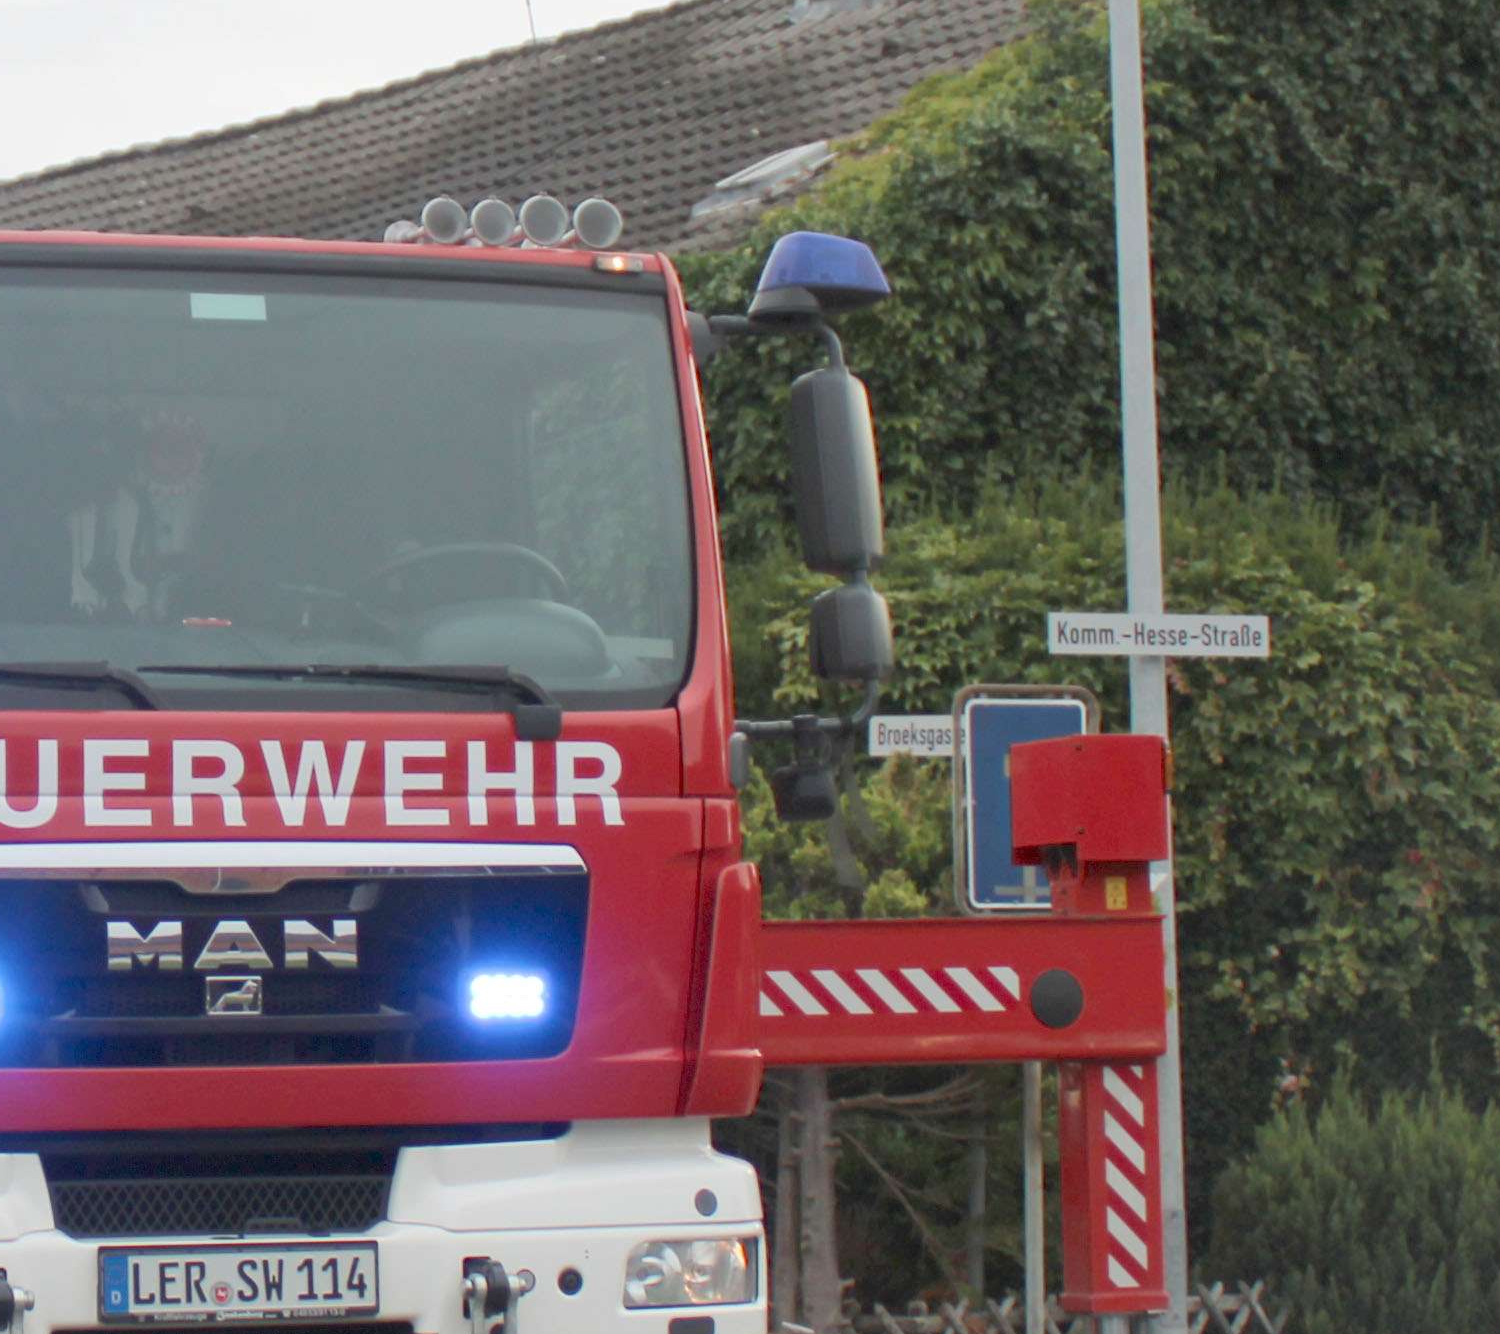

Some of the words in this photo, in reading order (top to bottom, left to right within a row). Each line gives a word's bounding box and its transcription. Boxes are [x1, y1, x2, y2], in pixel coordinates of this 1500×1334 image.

[1057, 620, 1262, 648] Komm.-Hesse-Straße
[877, 723, 966, 750] Broeksgase
[106, 919, 358, 970] MAN
[110, 1289, 122, 1304] D
[132, 1261, 207, 1305] LER
[236, 1258, 284, 1302] SW
[296, 1256, 367, 1300] 114
